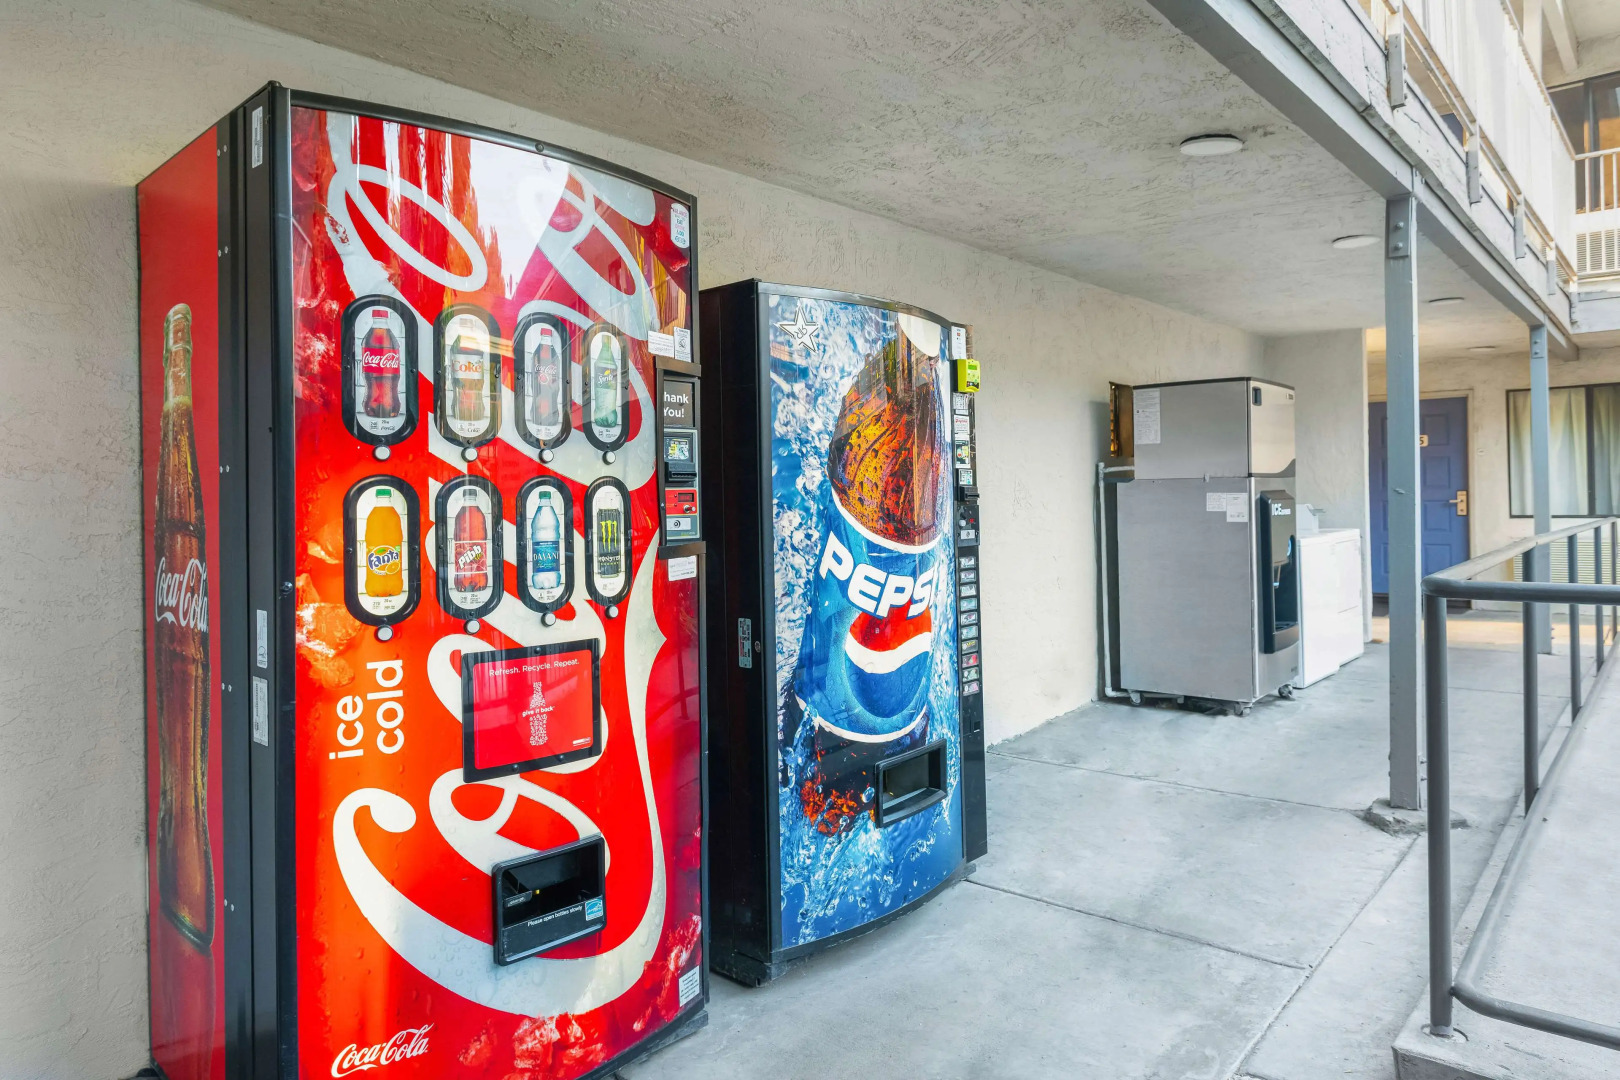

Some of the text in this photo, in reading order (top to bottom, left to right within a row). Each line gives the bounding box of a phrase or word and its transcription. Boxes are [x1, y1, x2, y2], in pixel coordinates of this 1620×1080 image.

[362, 351, 400, 369] Coca-Cola
[452, 361, 483, 373] Coke
[598, 374, 614, 386] Sprite
[663, 391, 689, 404] hank
[663, 406, 685, 418] You!
[458, 545, 483, 570] Pibb
[155, 557, 208, 633] Coca-Cola
[489, 659, 580, 677] Refresh. Recycle. Repeat.
[366, 659, 405, 755] cold
[522, 708, 535, 718] give
[329, 695, 364, 760] ice
[527, 918, 543, 927] Please
[543, 914, 555, 922] open
[555, 909, 570, 918] bottles
[570, 905, 583, 914] slowly
[331, 1022, 434, 1078] Coca-Cola
